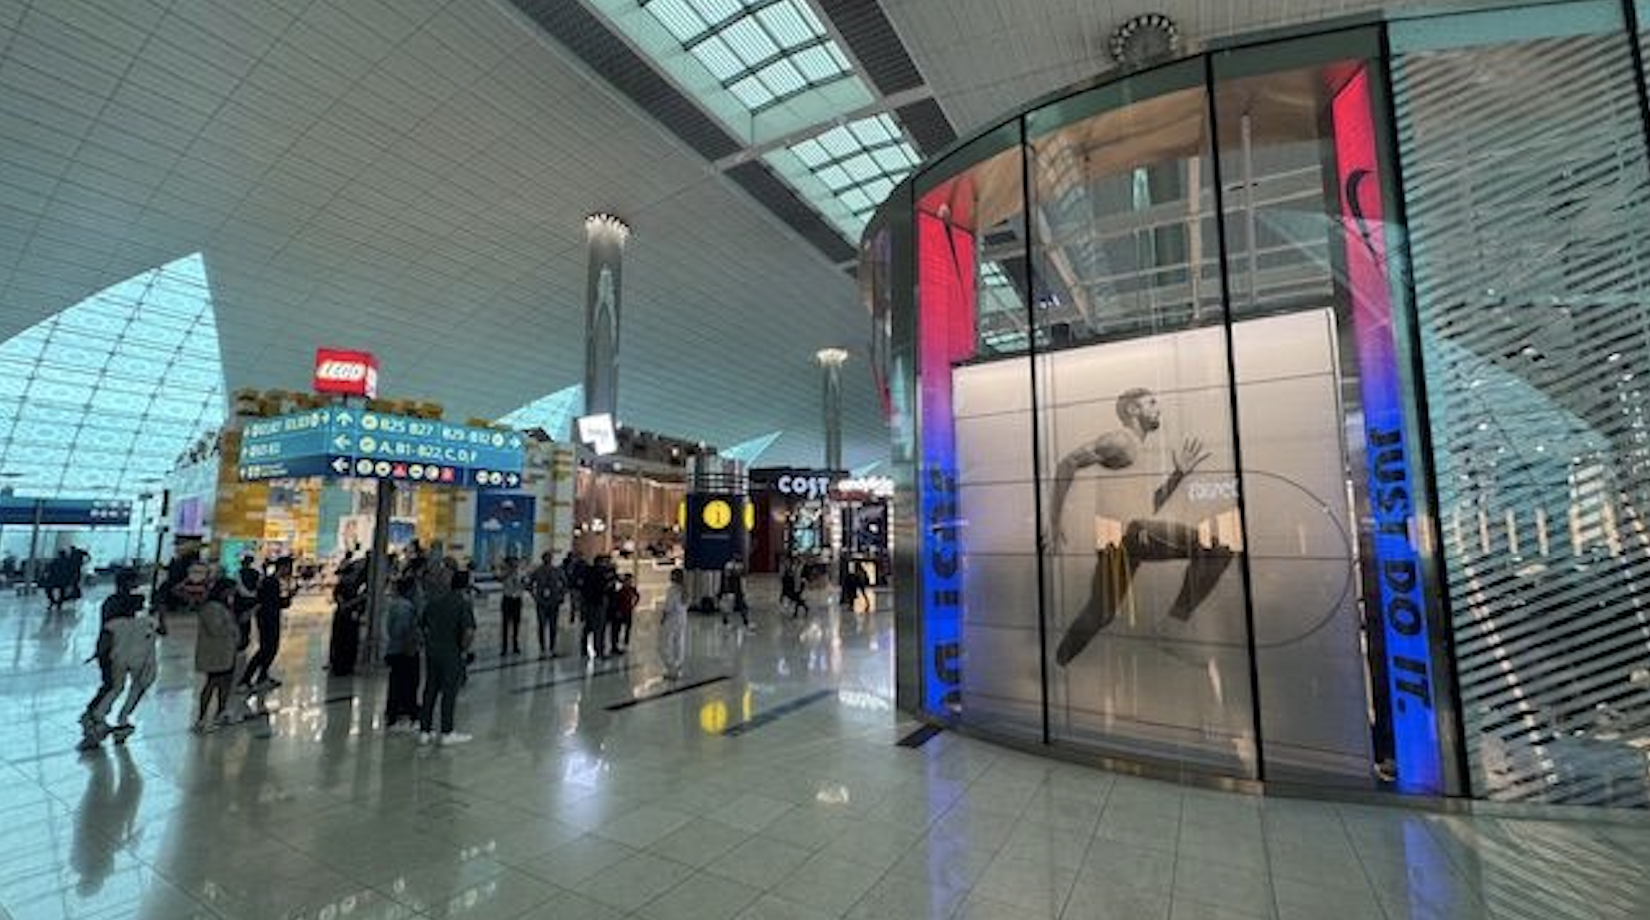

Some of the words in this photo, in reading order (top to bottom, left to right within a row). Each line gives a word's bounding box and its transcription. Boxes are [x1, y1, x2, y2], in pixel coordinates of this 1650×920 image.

[317, 360, 366, 380] LEGO
[778, 475, 832, 500] COST
[1368, 427, 1409, 541] JUST
[1384, 559, 1422, 635] DO
[1393, 655, 1431, 713] IT.
